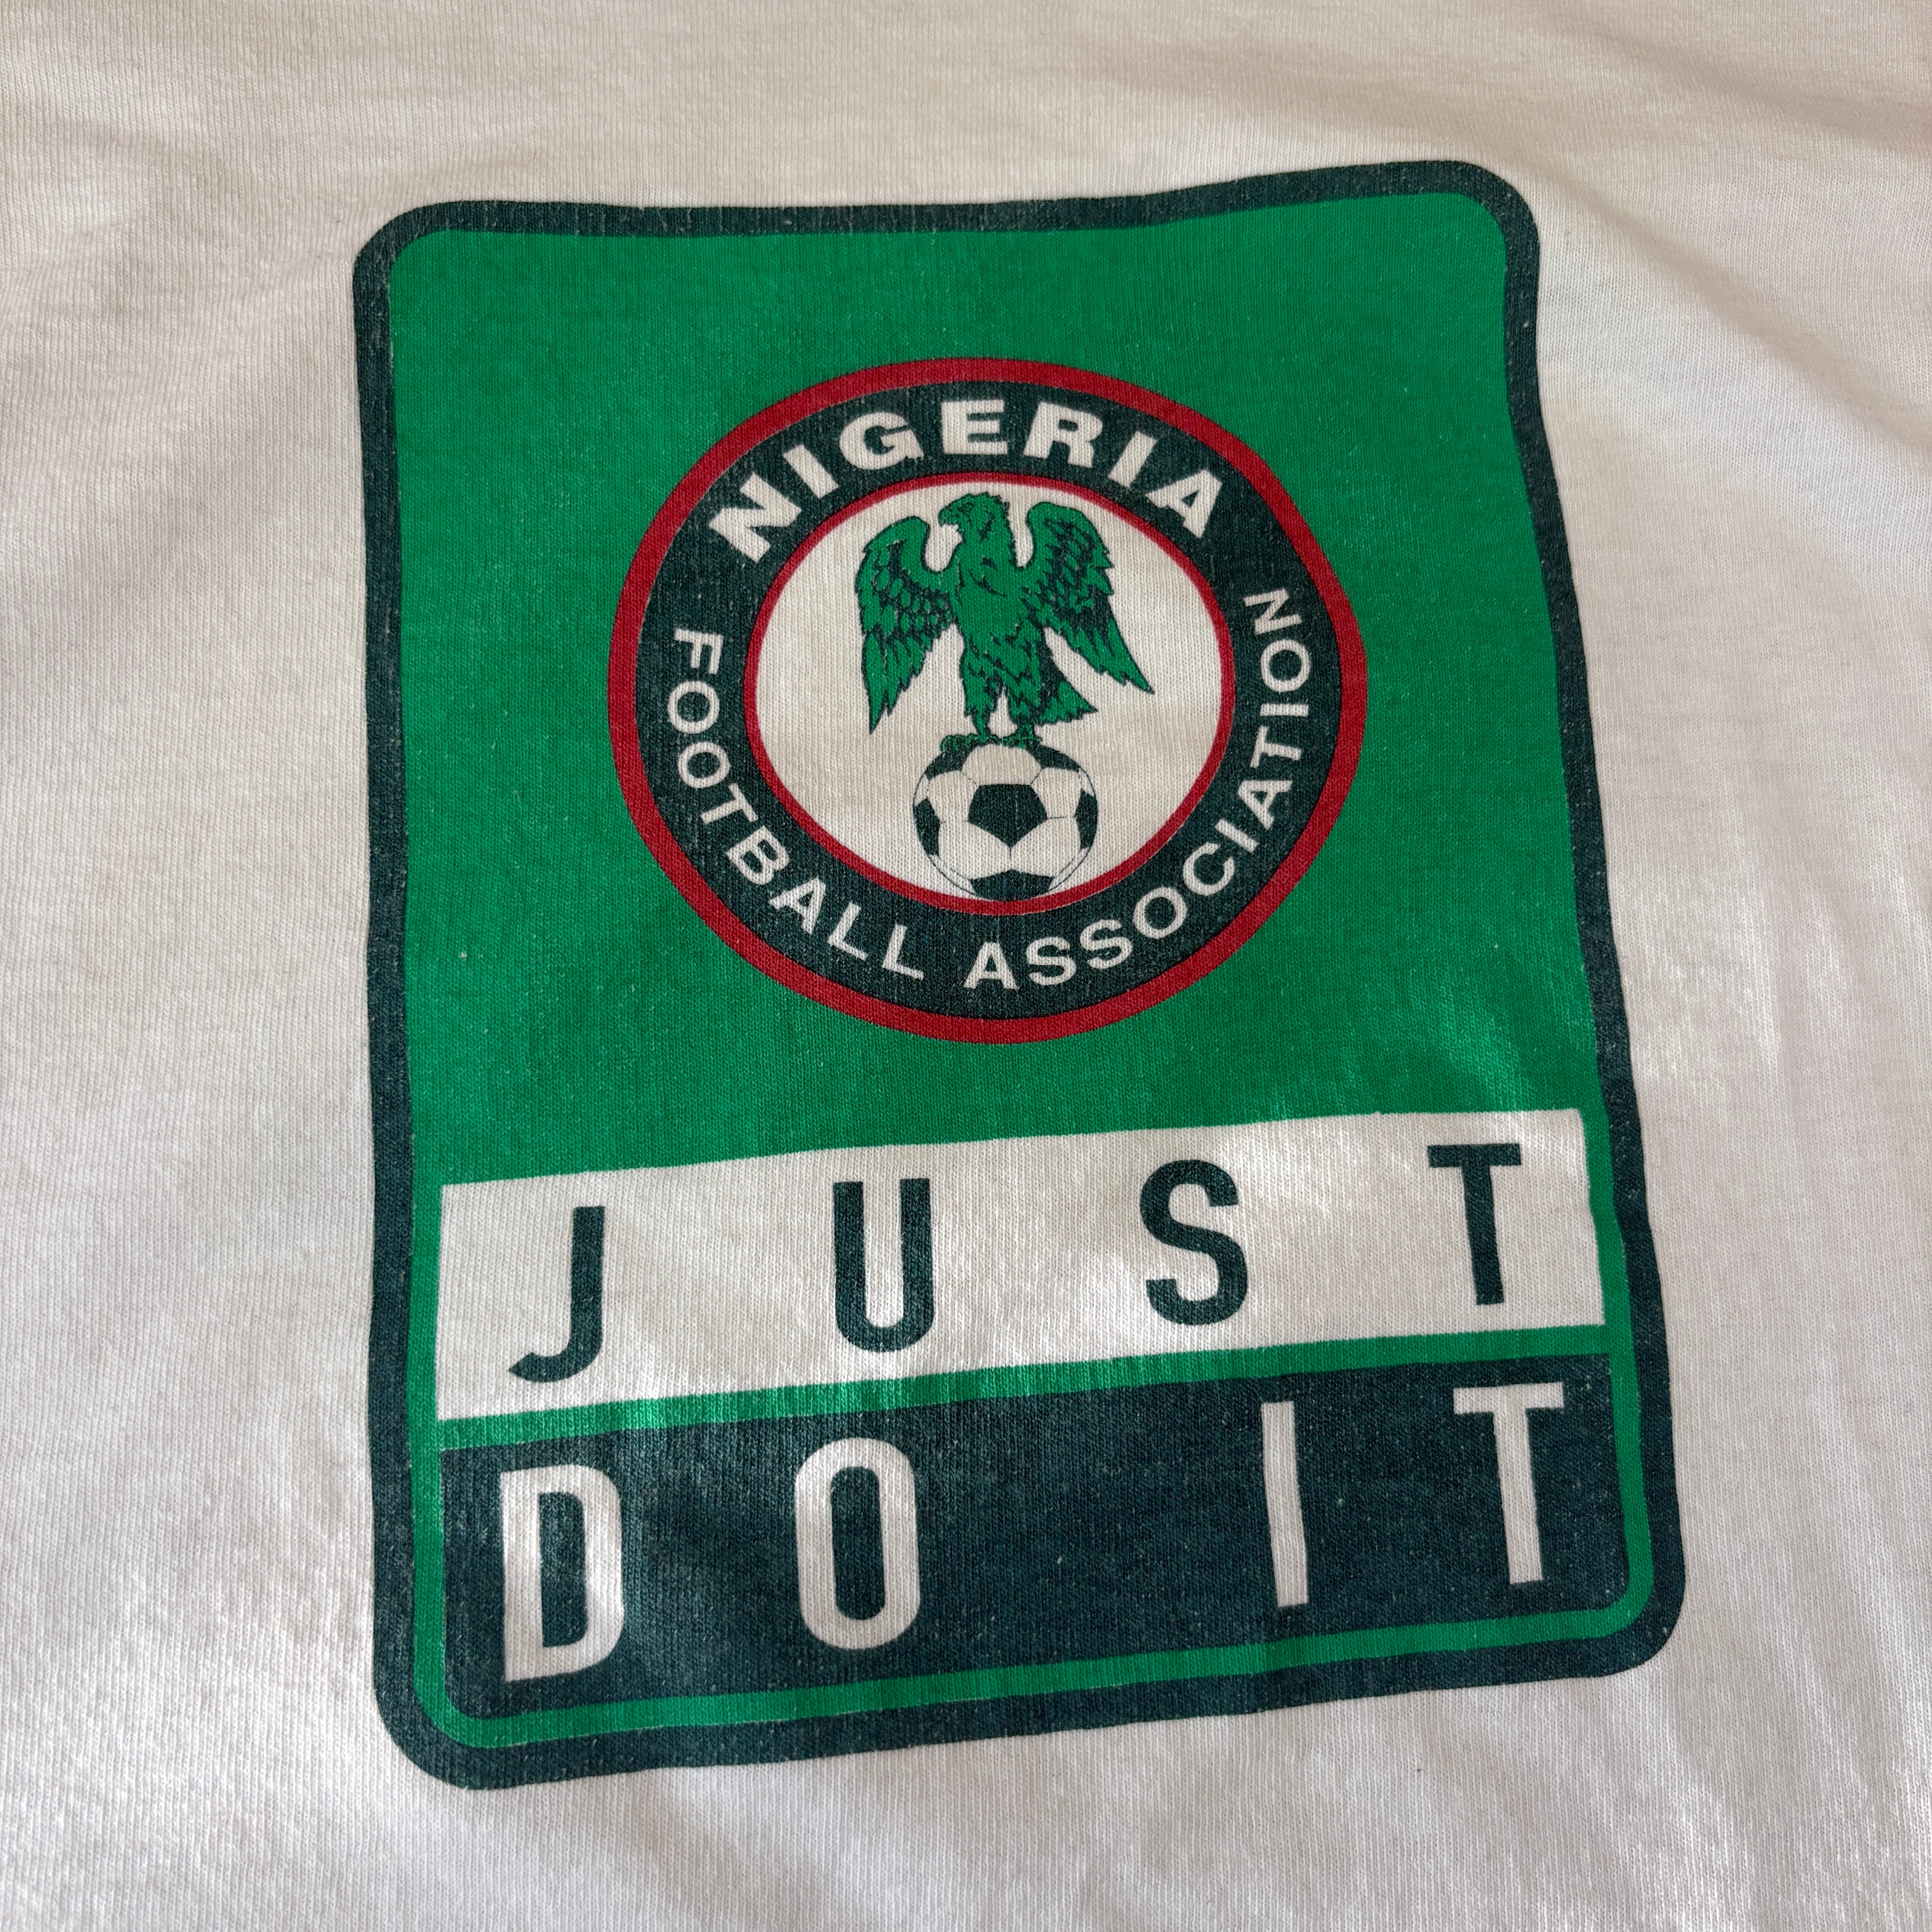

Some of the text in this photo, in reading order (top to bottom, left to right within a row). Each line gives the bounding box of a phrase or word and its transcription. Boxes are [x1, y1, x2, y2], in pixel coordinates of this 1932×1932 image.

[708, 399, 1227, 564] NIGERIA
[667, 588, 1311, 991] FOOTBALL ASSOCIATION
[506, 1142, 1523, 1384] JUST
[501, 1383, 1564, 1683] DO IT
